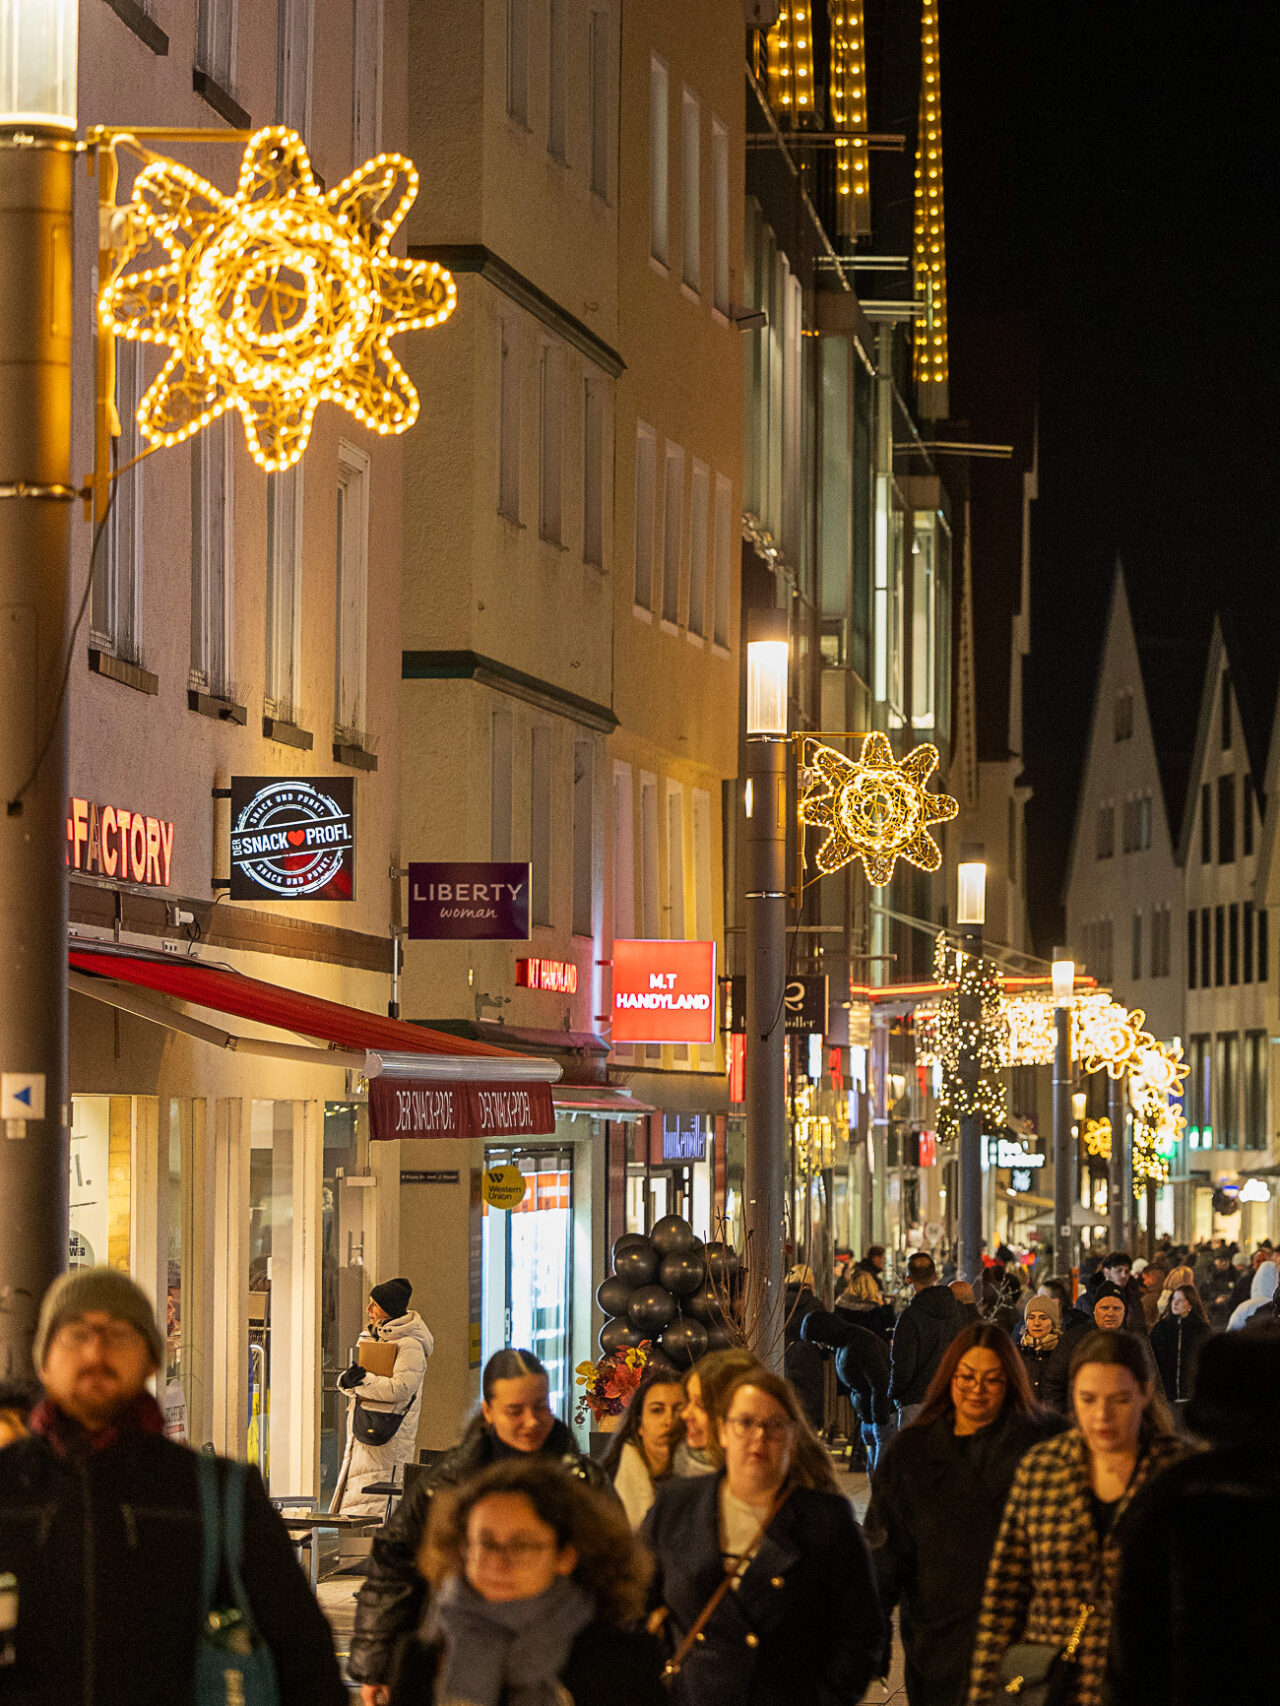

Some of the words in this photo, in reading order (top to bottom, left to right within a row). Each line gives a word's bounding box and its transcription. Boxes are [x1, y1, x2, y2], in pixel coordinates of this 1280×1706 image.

[249, 798, 274, 825] SNACK
[274, 792, 294, 803] UND
[297, 793, 325, 816] PUNKT.
[231, 838, 243, 857] DER
[241, 831, 290, 855] SNACK
[256, 863, 284, 884] SNACK
[286, 877, 305, 886] UND
[413, 883, 523, 901] LIBERTY
[440, 906, 498, 919] woman
[540, 959, 578, 994] HANDYLAND
[649, 973, 678, 989] M.T
[616, 993, 710, 1010] HANDYLAND
[395, 1090, 412, 1131] DER
[488, 1185, 521, 1193] Western
[488, 1192, 512, 1200] Union
